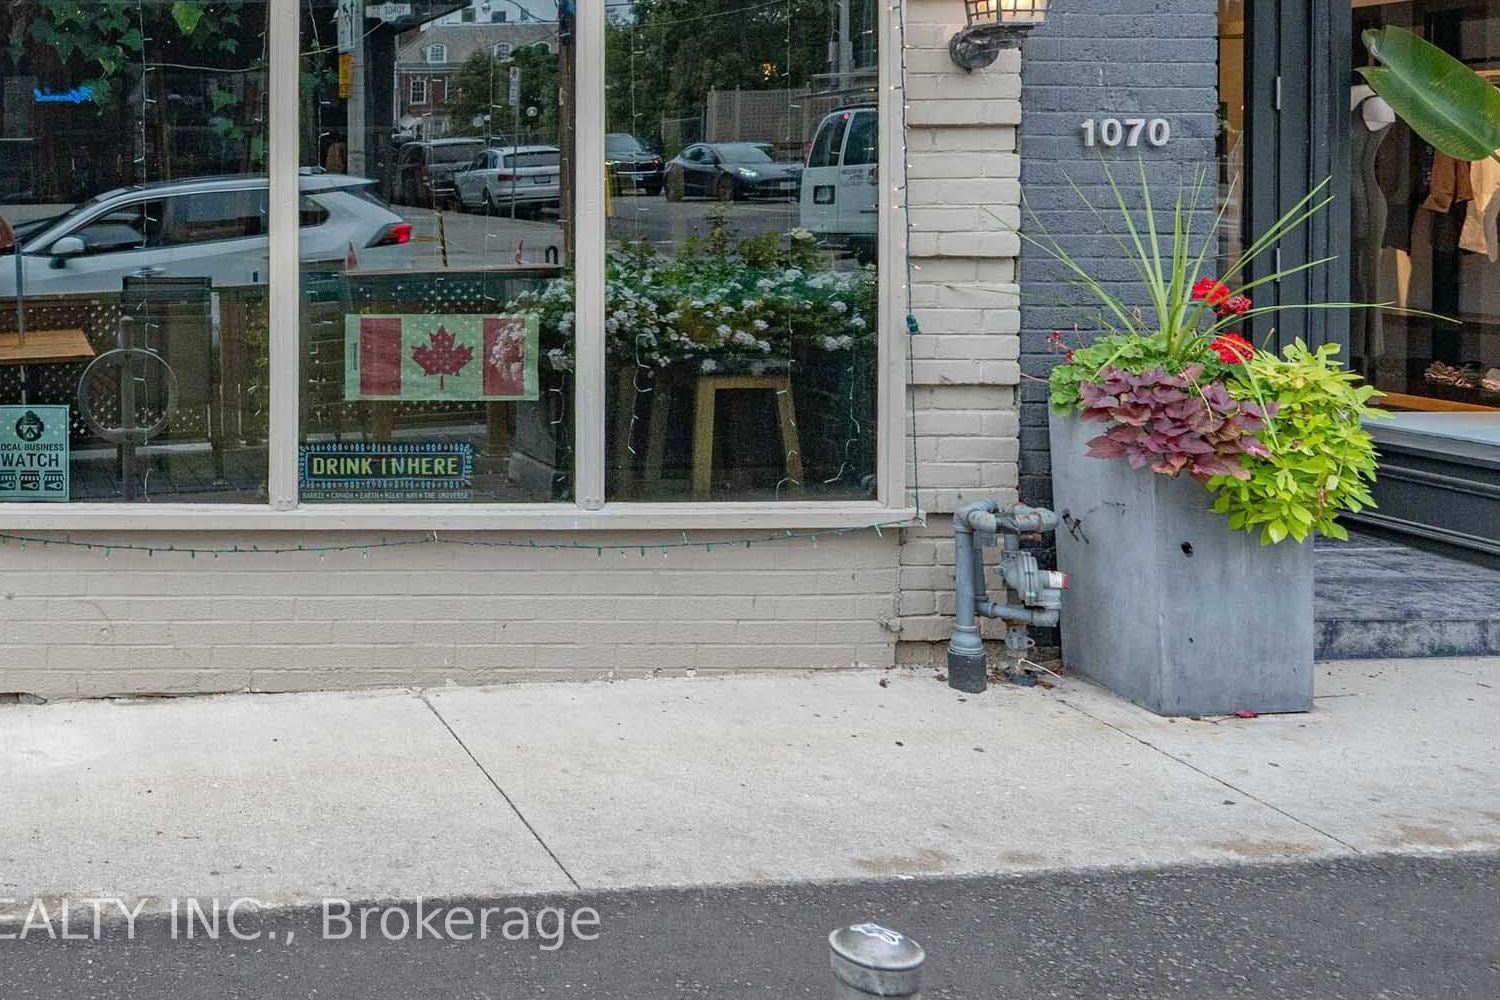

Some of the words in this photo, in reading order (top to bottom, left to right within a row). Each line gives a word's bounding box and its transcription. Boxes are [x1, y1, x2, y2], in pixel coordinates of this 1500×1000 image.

[1081, 118, 1171, 147] 1070
[24, 443, 64, 451] BUSINESS
[1, 453, 59, 467] WATCH
[312, 457, 373, 475] DRINK
[381, 457, 405, 475] IN
[407, 457, 459, 475] HERE
